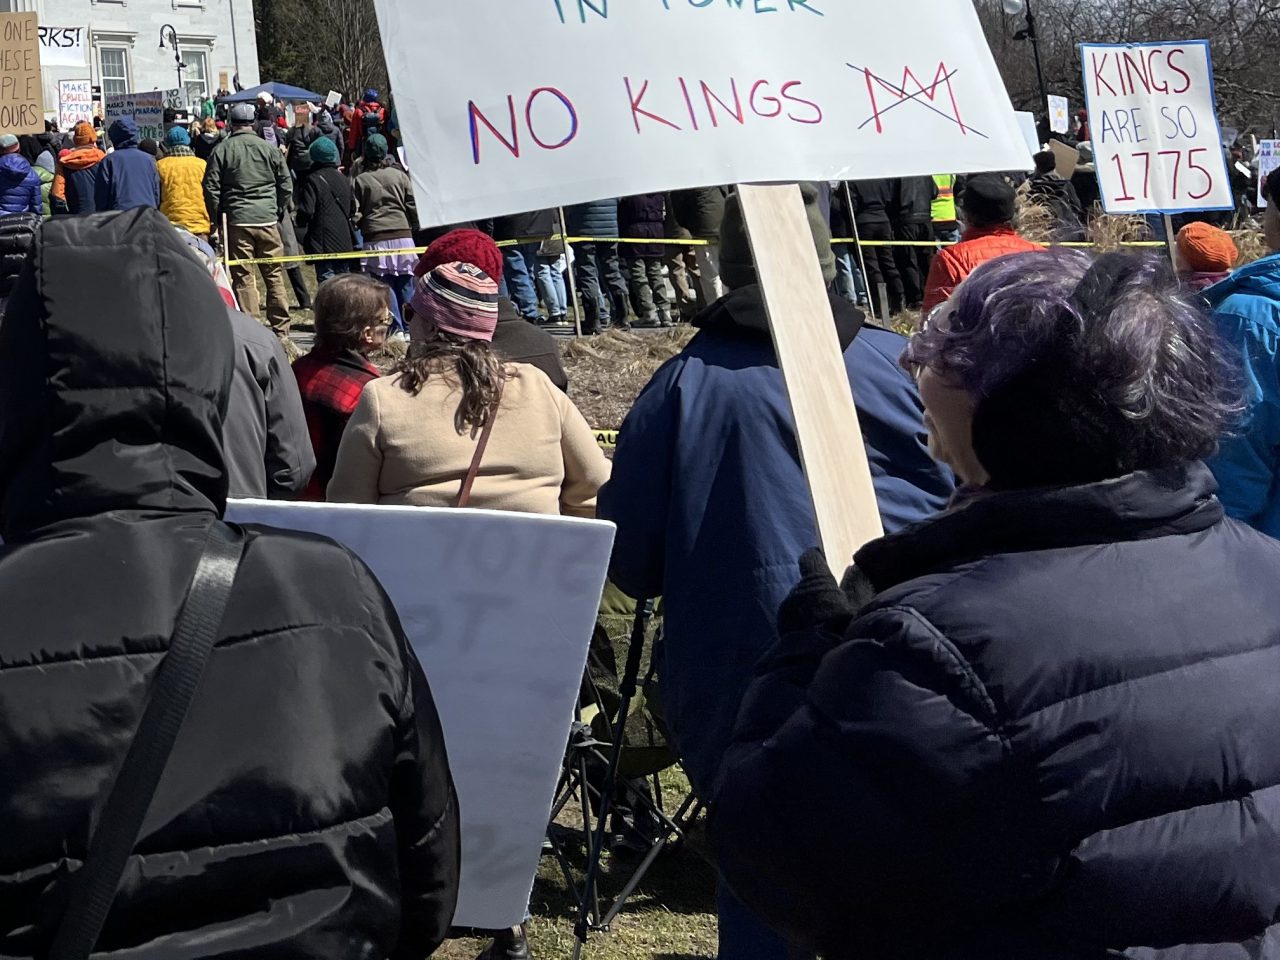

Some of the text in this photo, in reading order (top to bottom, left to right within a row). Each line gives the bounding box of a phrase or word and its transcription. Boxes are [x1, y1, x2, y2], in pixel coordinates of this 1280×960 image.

[63, 83, 88, 92] MAKE
[1092, 49, 1192, 97] KINGS
[1, 103, 37, 129] OURS
[60, 103, 92, 112] FICTION
[468, 76, 823, 164] NO KINGS
[1101, 105, 1197, 143] ARE SO
[1111, 148, 1213, 202] 1775
